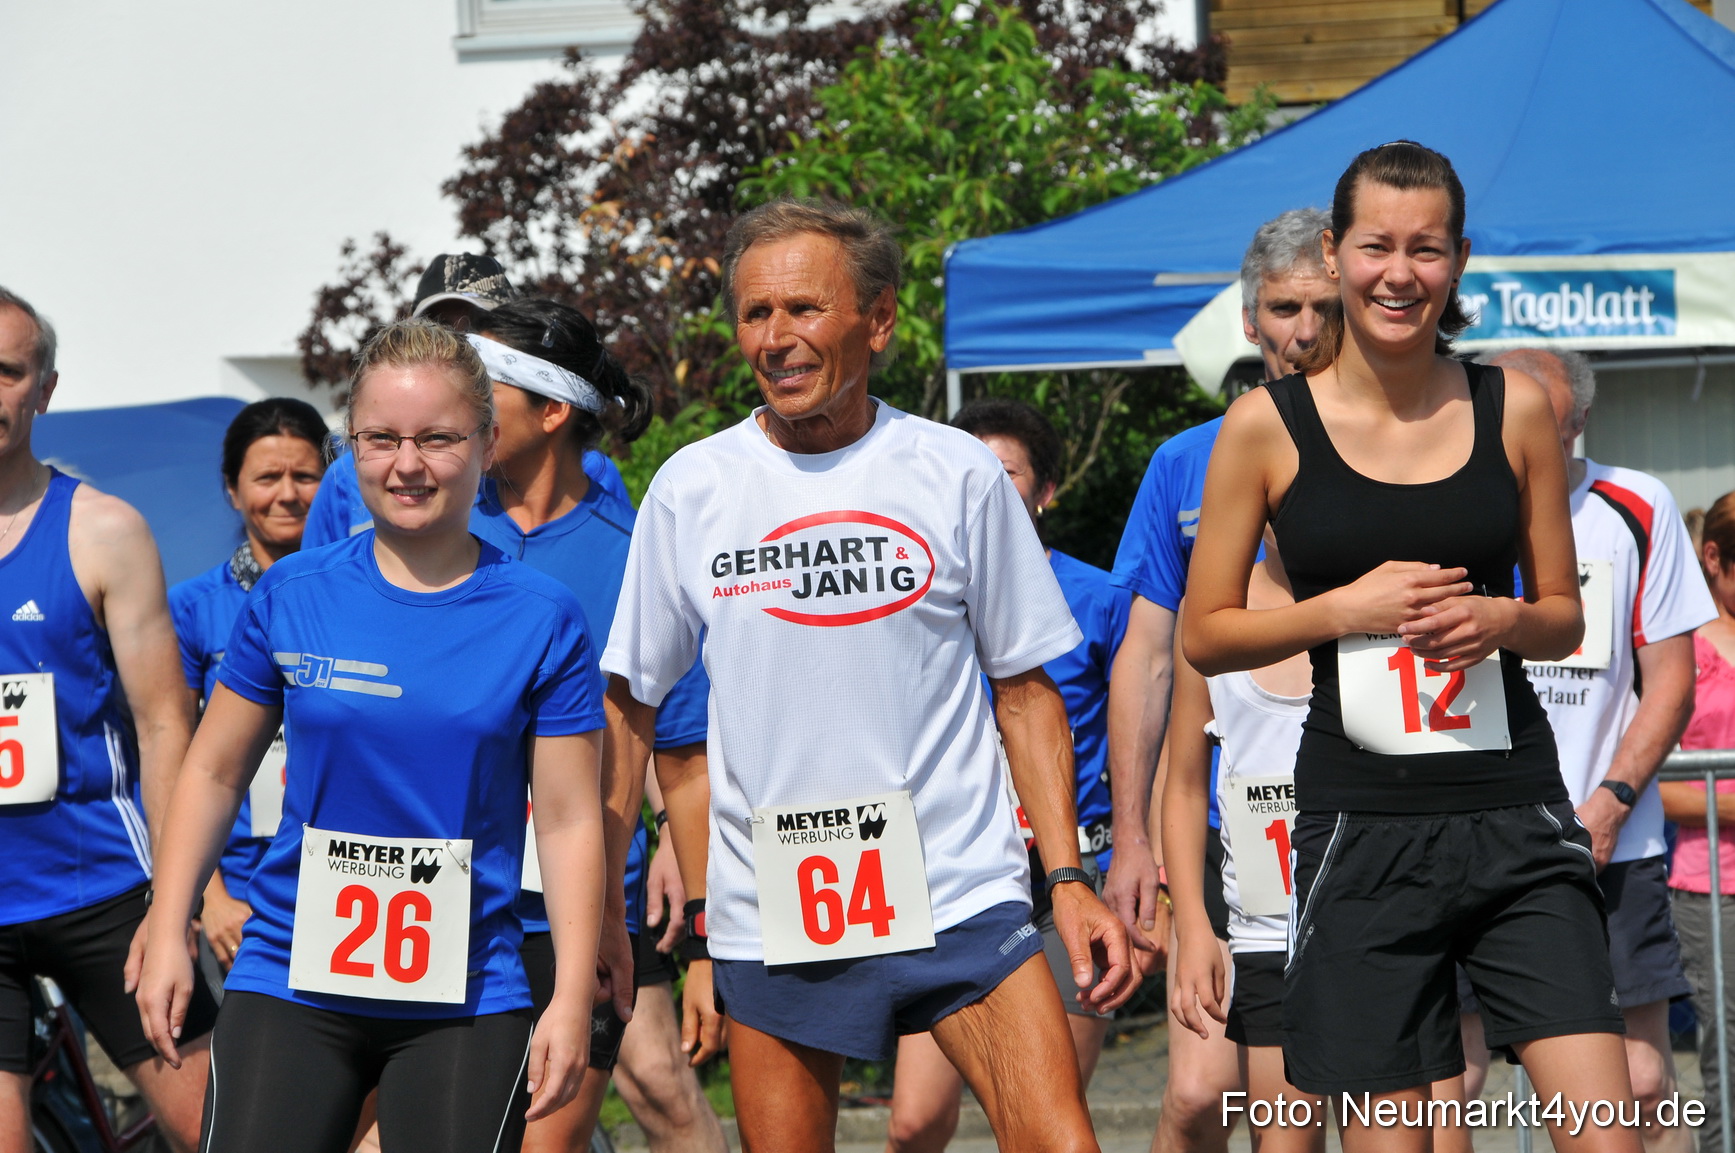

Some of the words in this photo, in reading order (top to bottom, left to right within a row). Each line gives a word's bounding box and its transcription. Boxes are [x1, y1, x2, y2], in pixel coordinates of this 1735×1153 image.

[1491, 281, 1655, 331] Tagblatt
[711, 537, 889, 578] GERHART
[895, 546, 909, 560] &
[712, 578, 792, 599] Autohaus
[791, 566, 915, 600] JÄNIG
[12, 612, 45, 622] adidas
[1387, 646, 1471, 734] 12
[1538, 686, 1590, 705] rlauf
[0, 715, 25, 789] 5
[1247, 783, 1295, 801] MEYE
[1247, 800, 1297, 814] WERBUN
[777, 807, 852, 832] MEYER
[777, 827, 854, 846] WERBUNG
[328, 839, 405, 865] MEYER
[1264, 819, 1292, 896] 1
[328, 858, 405, 880] WERBUNG
[797, 848, 896, 946] 64
[330, 884, 432, 984] 26
